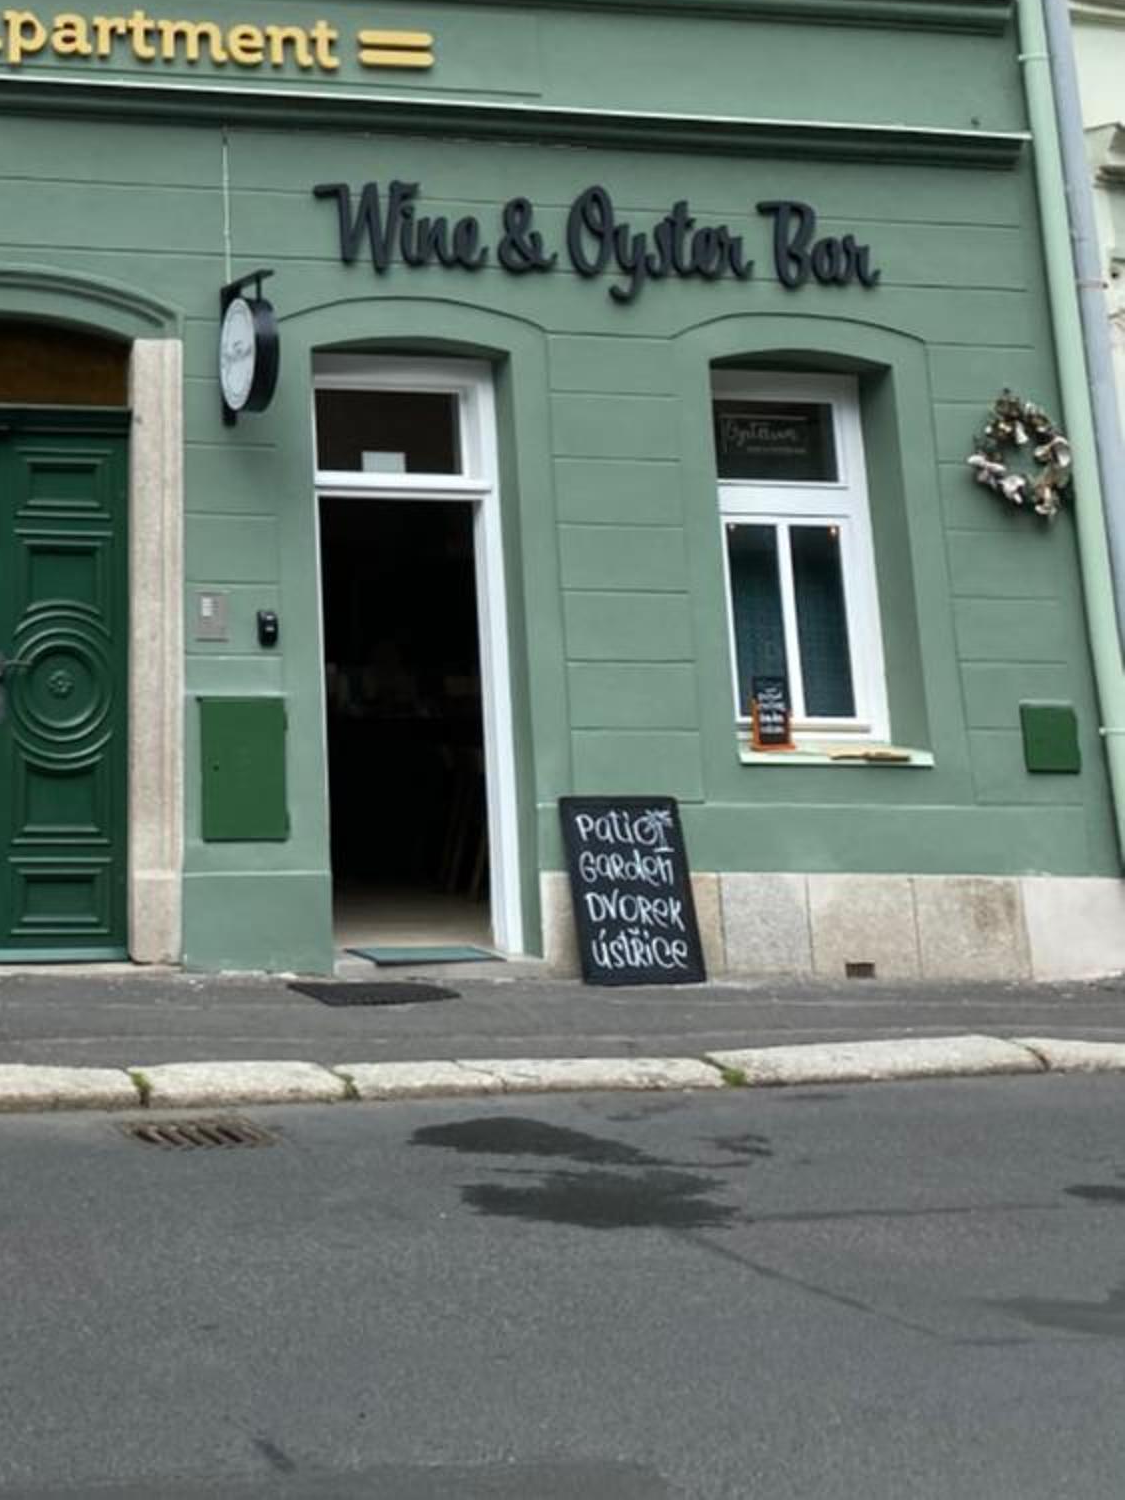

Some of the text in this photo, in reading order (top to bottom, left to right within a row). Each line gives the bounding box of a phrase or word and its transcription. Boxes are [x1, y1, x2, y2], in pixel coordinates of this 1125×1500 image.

[313, 179, 881, 304] Wine & Oyster Bar
